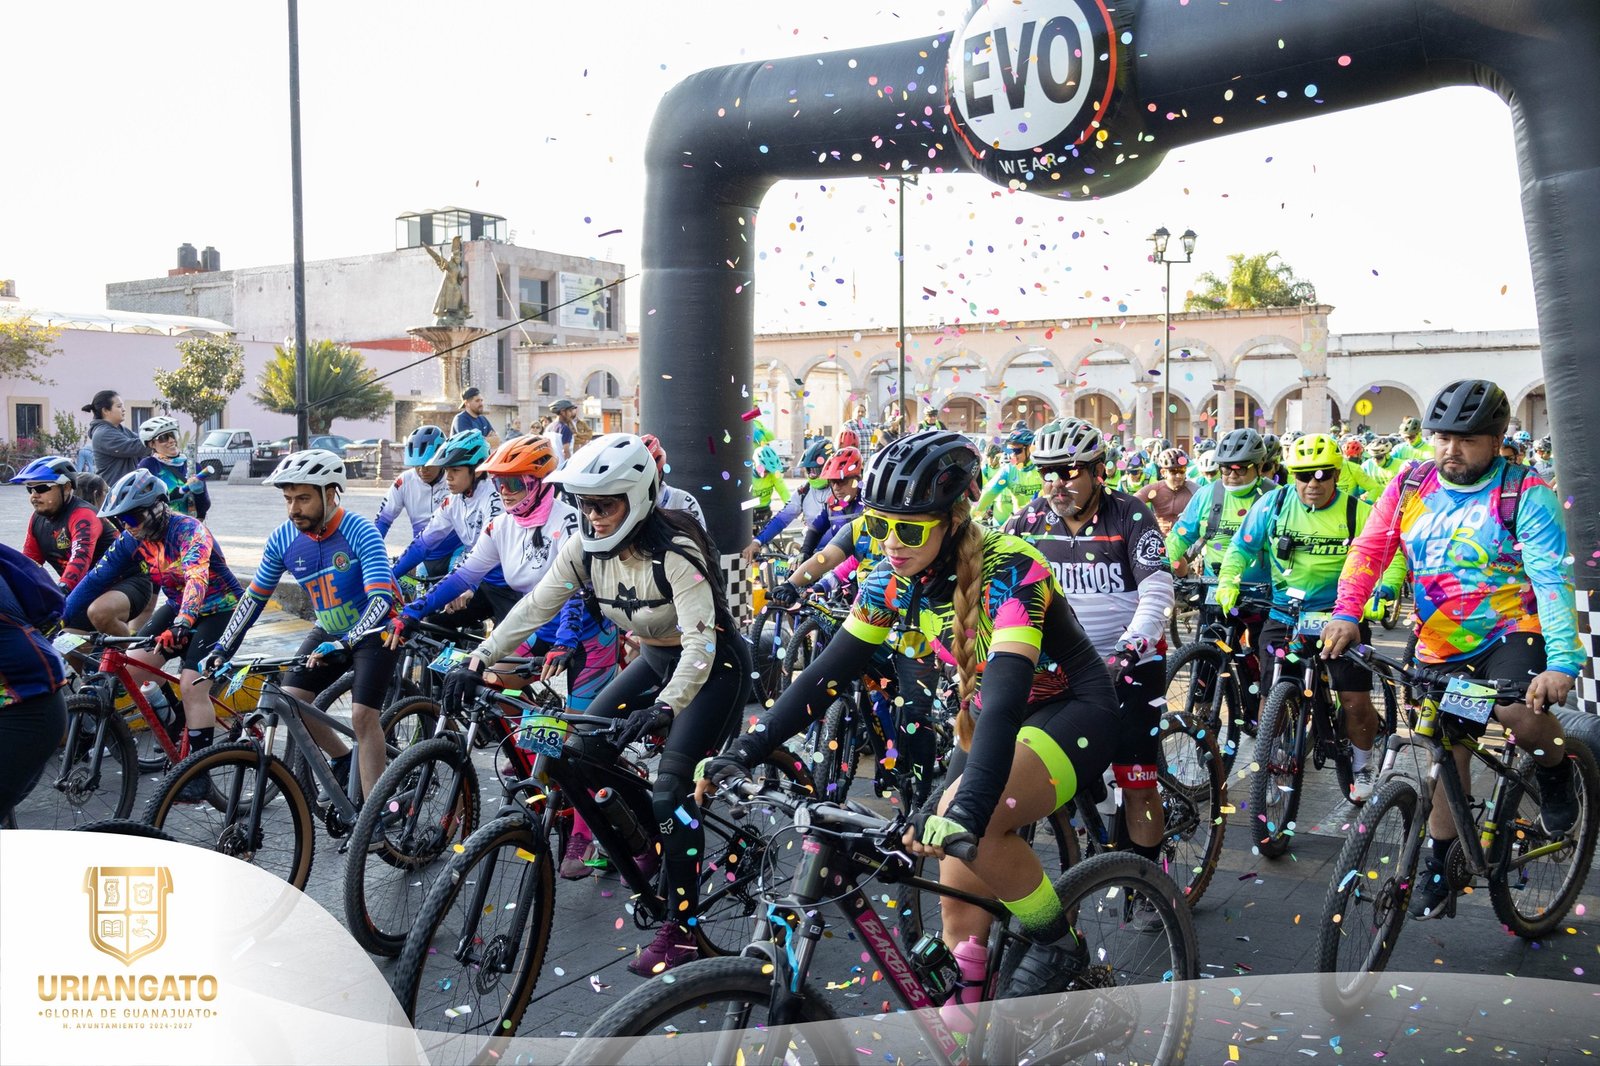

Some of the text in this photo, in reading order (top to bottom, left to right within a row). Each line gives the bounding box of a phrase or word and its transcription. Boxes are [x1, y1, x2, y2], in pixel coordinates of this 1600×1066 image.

[964, 16, 1083, 119] EVO
[999, 153, 1058, 175] WEAR
[1311, 544, 1348, 555] MTB
[305, 573, 342, 610] FIE
[525, 724, 560, 747] 148
[861, 919, 954, 1050] BARBIES BIKE
